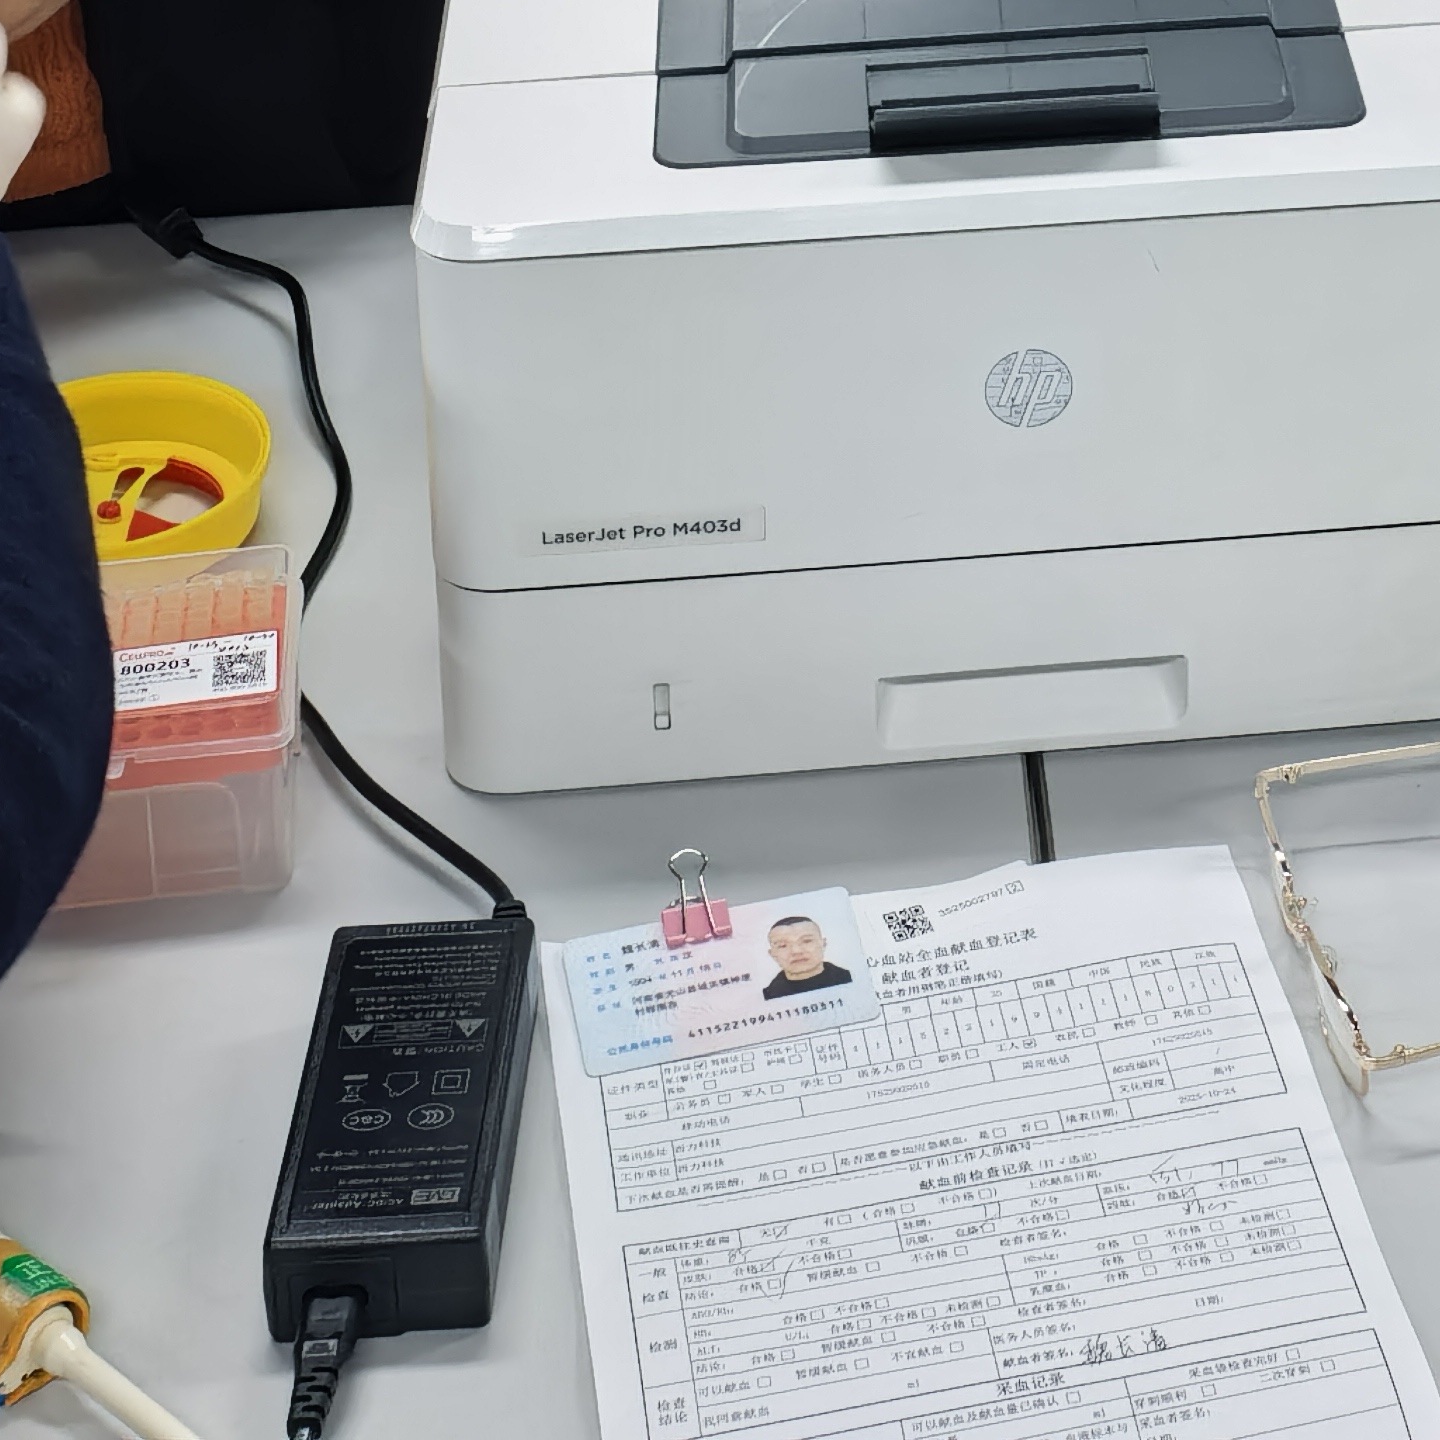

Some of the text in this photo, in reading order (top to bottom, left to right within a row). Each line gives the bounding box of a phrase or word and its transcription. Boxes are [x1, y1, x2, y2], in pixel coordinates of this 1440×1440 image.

[990, 349, 1069, 427] hp
[542, 518, 741, 545] LaserJet Pro M403d
[120, 658, 191, 675] 800203
[881, 958, 969, 985] 献血者登记
[996, 1041, 1019, 1053] 工人
[918, 1159, 1032, 1191] 献血前检查记录
[698, 1379, 750, 1398] 可以献血
[995, 1371, 1065, 1396] 采血记录
